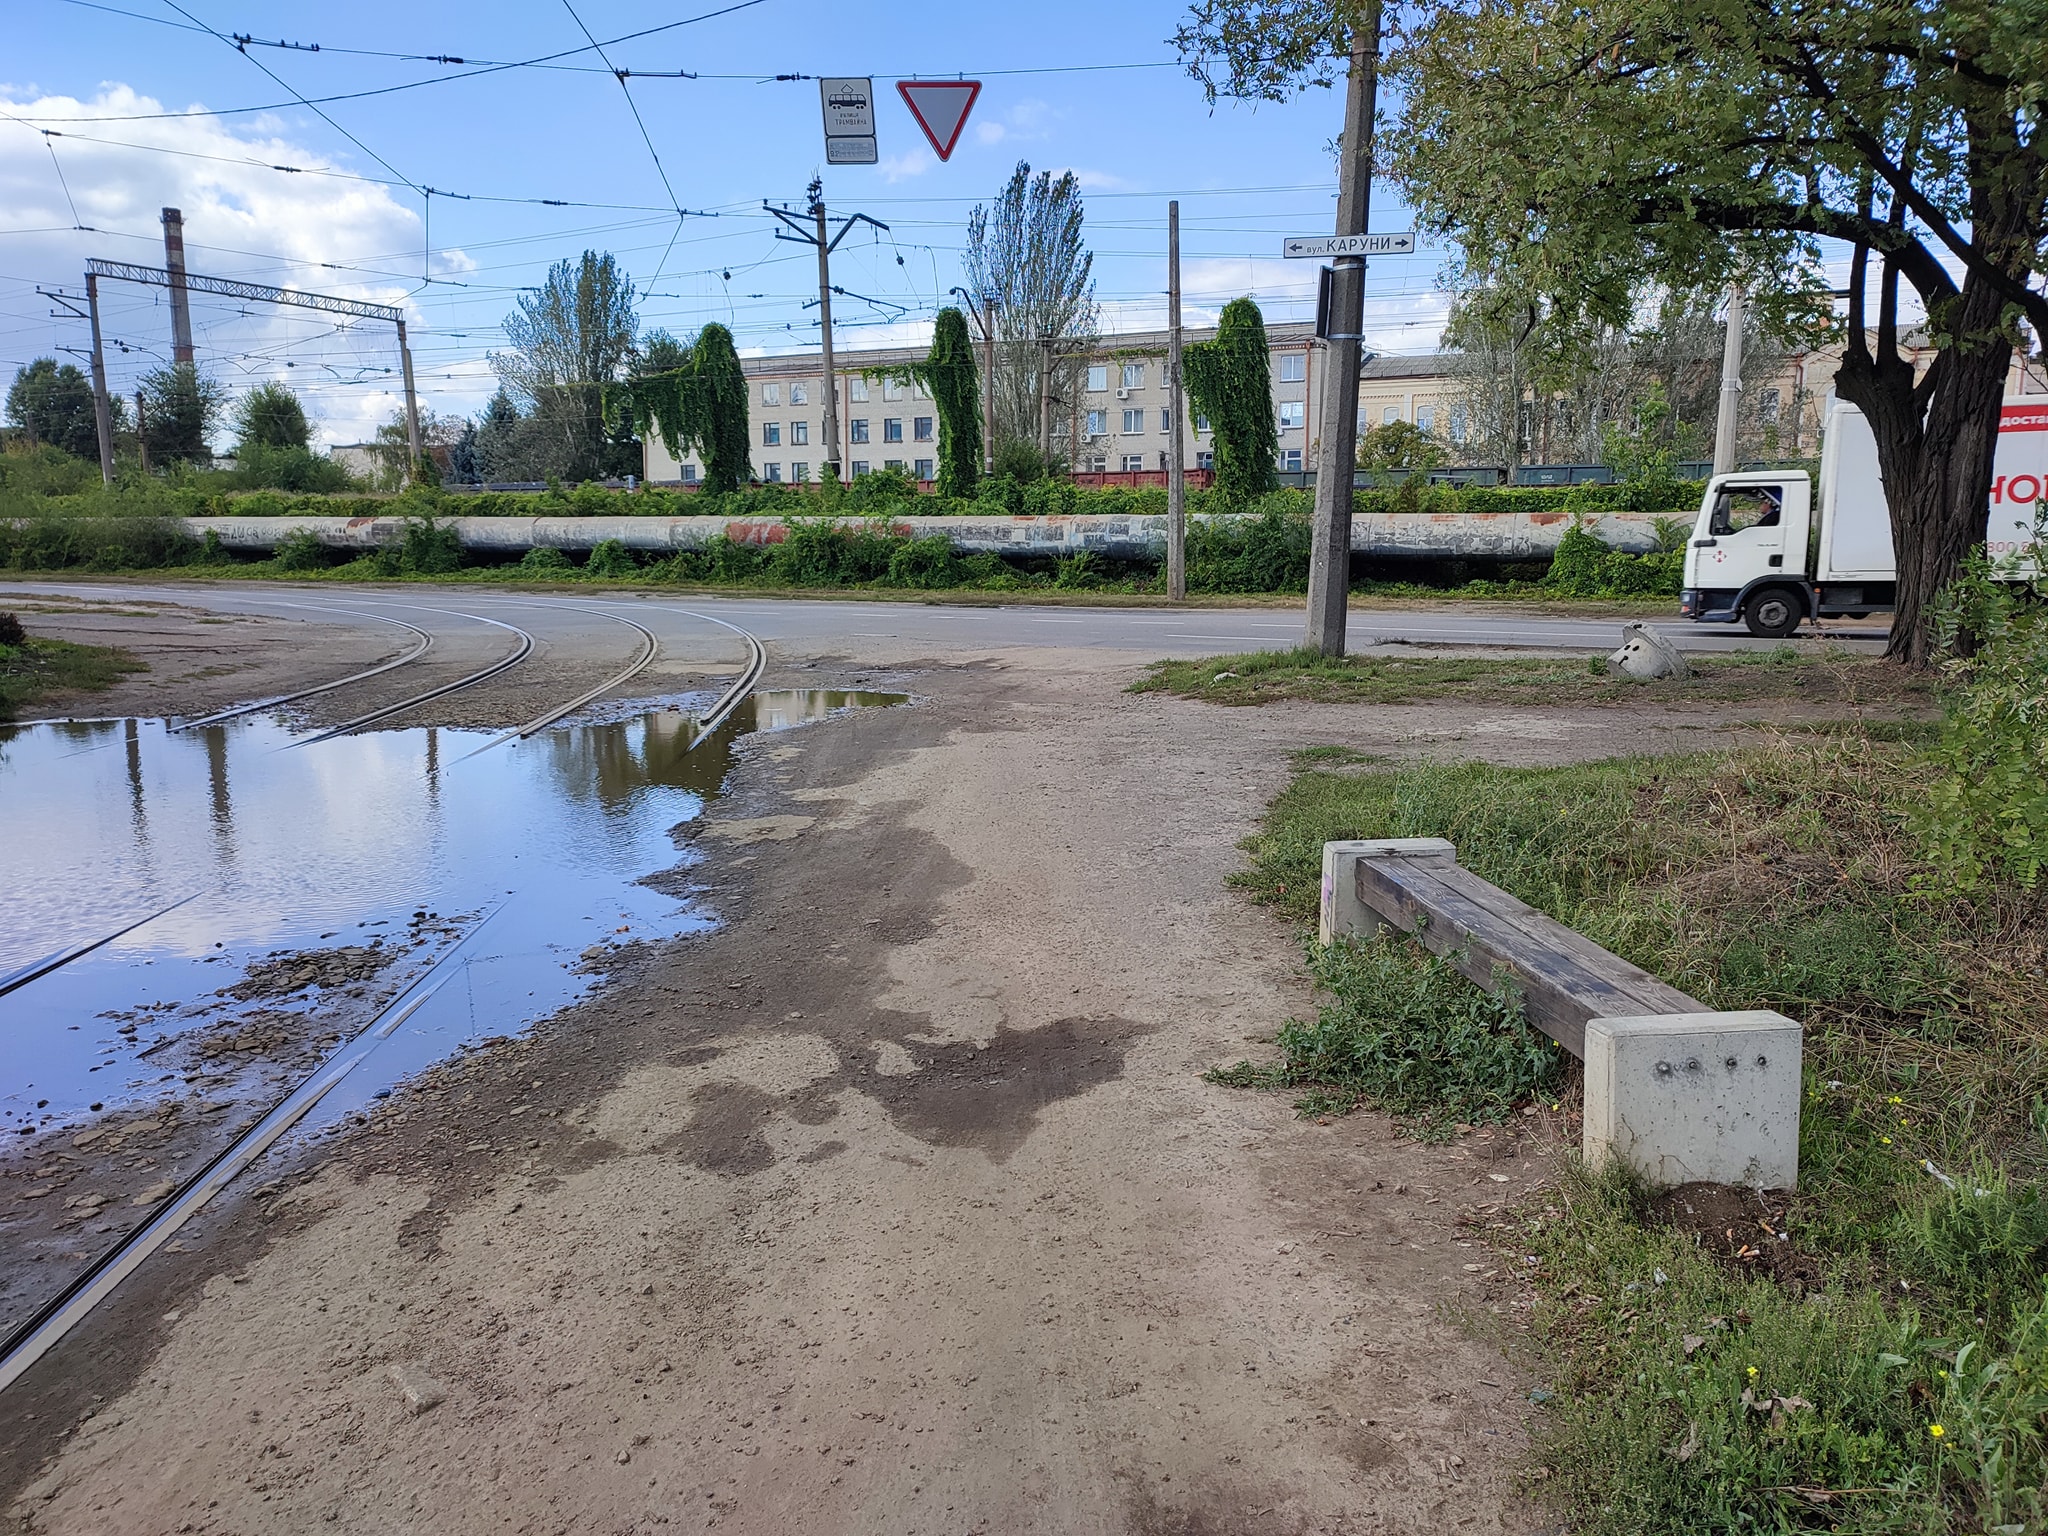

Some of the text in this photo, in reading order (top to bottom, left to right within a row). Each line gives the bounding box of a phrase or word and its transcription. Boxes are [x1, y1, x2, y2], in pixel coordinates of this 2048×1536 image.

[1306, 237, 1391, 255] вул. КАРУНИ
[1999, 415, 2048, 427] доста
